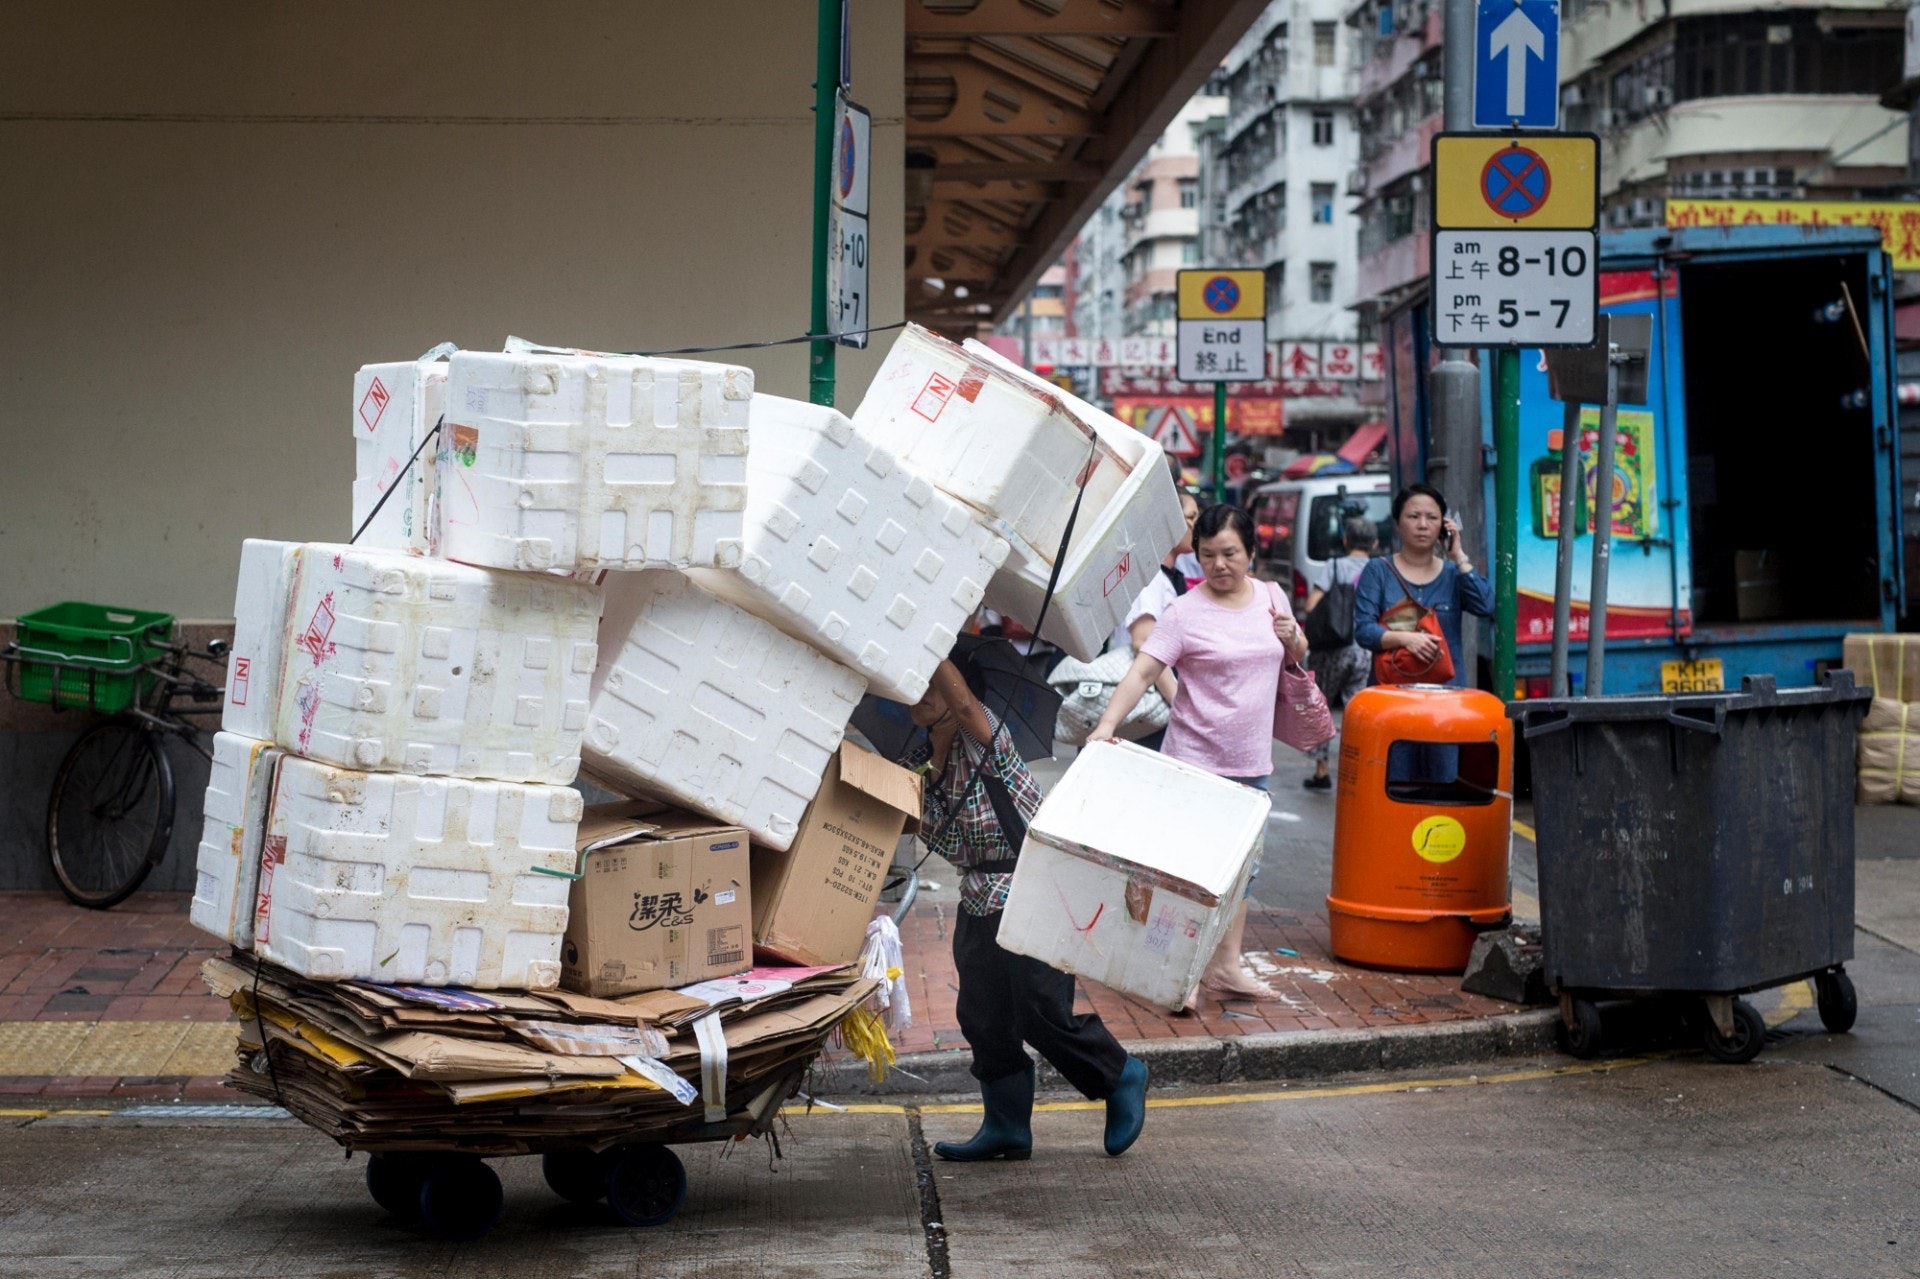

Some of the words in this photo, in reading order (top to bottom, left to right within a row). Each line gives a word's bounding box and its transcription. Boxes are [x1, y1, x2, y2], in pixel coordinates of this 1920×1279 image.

[1453, 240, 1481, 255] am
[1497, 245, 1587, 279] 8-10
[1445, 260, 1490, 281] 上午
[1453, 293, 1481, 310] pm
[1497, 299, 1571, 329] 5-7
[1445, 312, 1490, 333] 下午
[1203, 328, 1241, 344] End
[1195, 351, 1247, 374] 終止
[1678, 662, 1705, 678] KH
[837, 856, 849, 869] KGS
[831, 866, 844, 878] PCS
[660, 913, 694, 928] C&S
